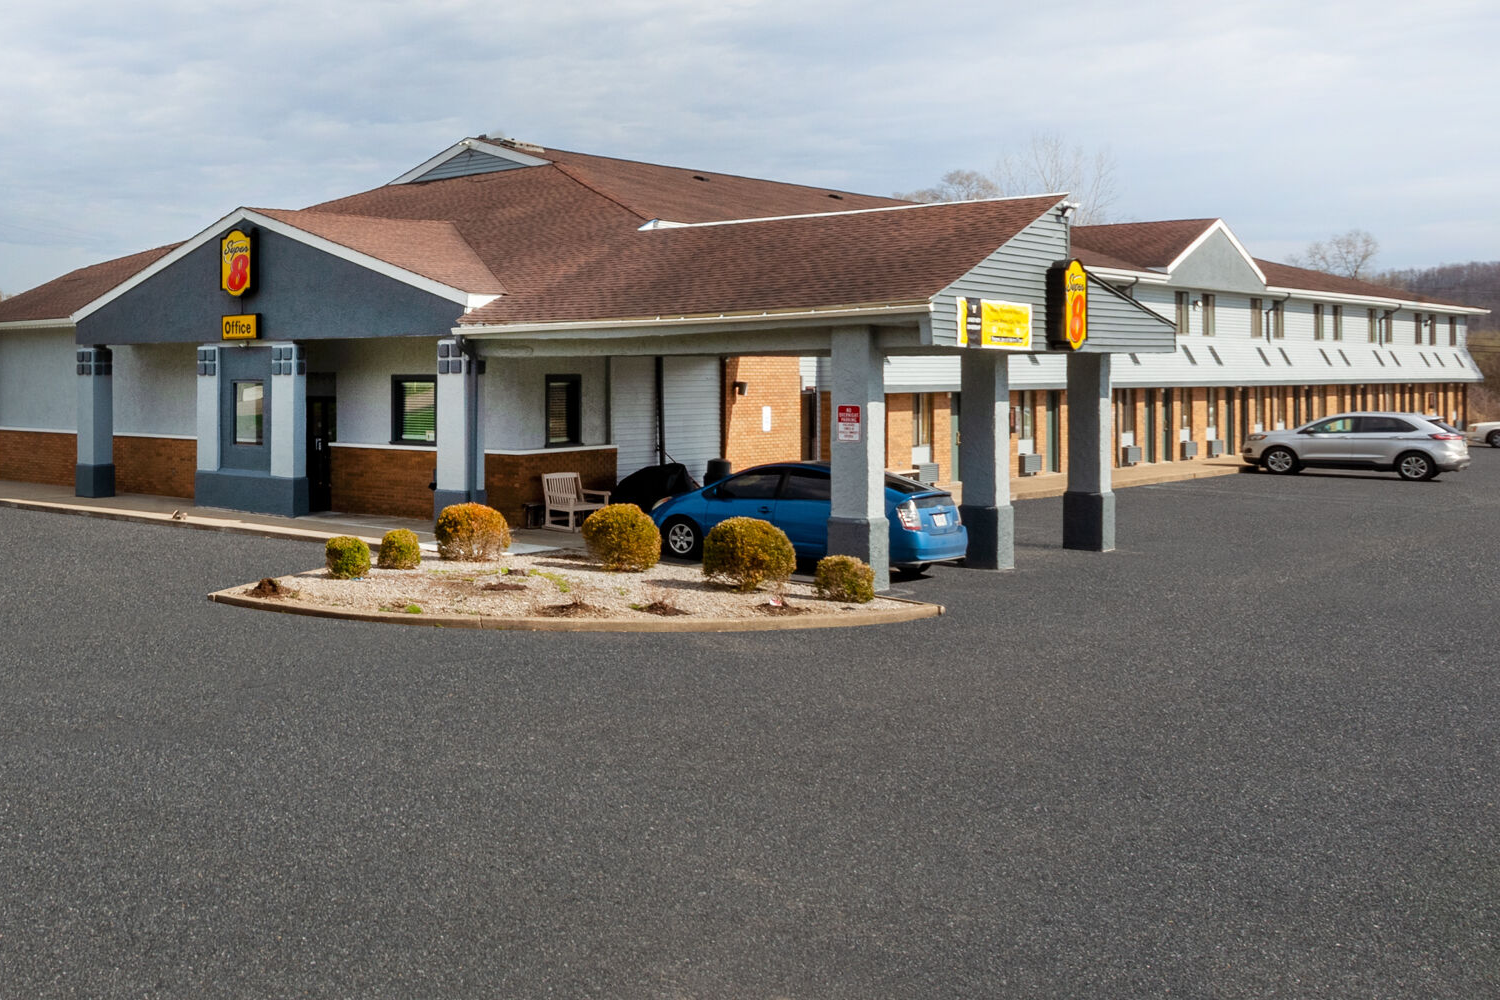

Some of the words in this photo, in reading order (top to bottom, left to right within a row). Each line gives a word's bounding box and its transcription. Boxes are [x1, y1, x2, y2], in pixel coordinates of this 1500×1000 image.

[224, 240, 249, 261] Super
[227, 254, 249, 292] 8
[224, 320, 251, 335] Office
[1070, 294, 1084, 343] 8
